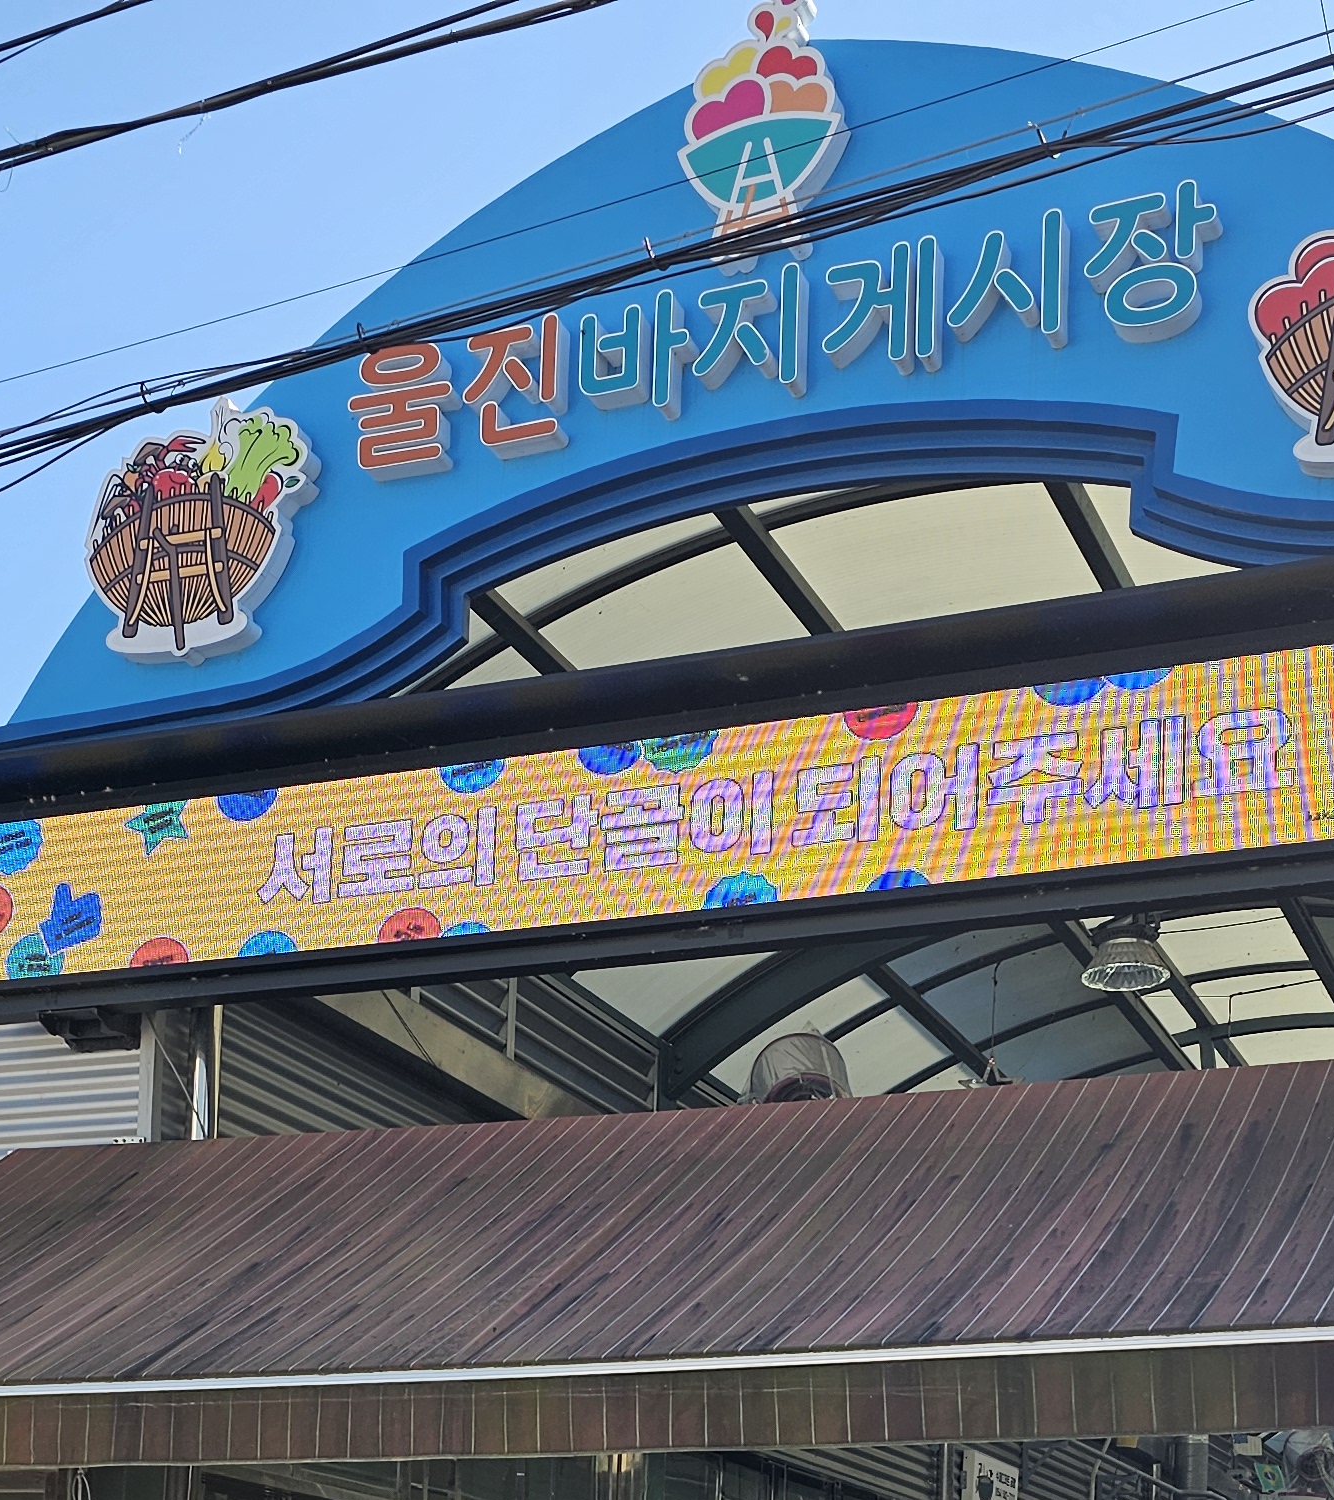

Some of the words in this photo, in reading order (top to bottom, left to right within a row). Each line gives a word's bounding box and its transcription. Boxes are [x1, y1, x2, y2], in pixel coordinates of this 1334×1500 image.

[257, 804, 497, 904] 서로의
[515, 769, 775, 882] 단골이
[791, 707, 1296, 847] 되어주세요
